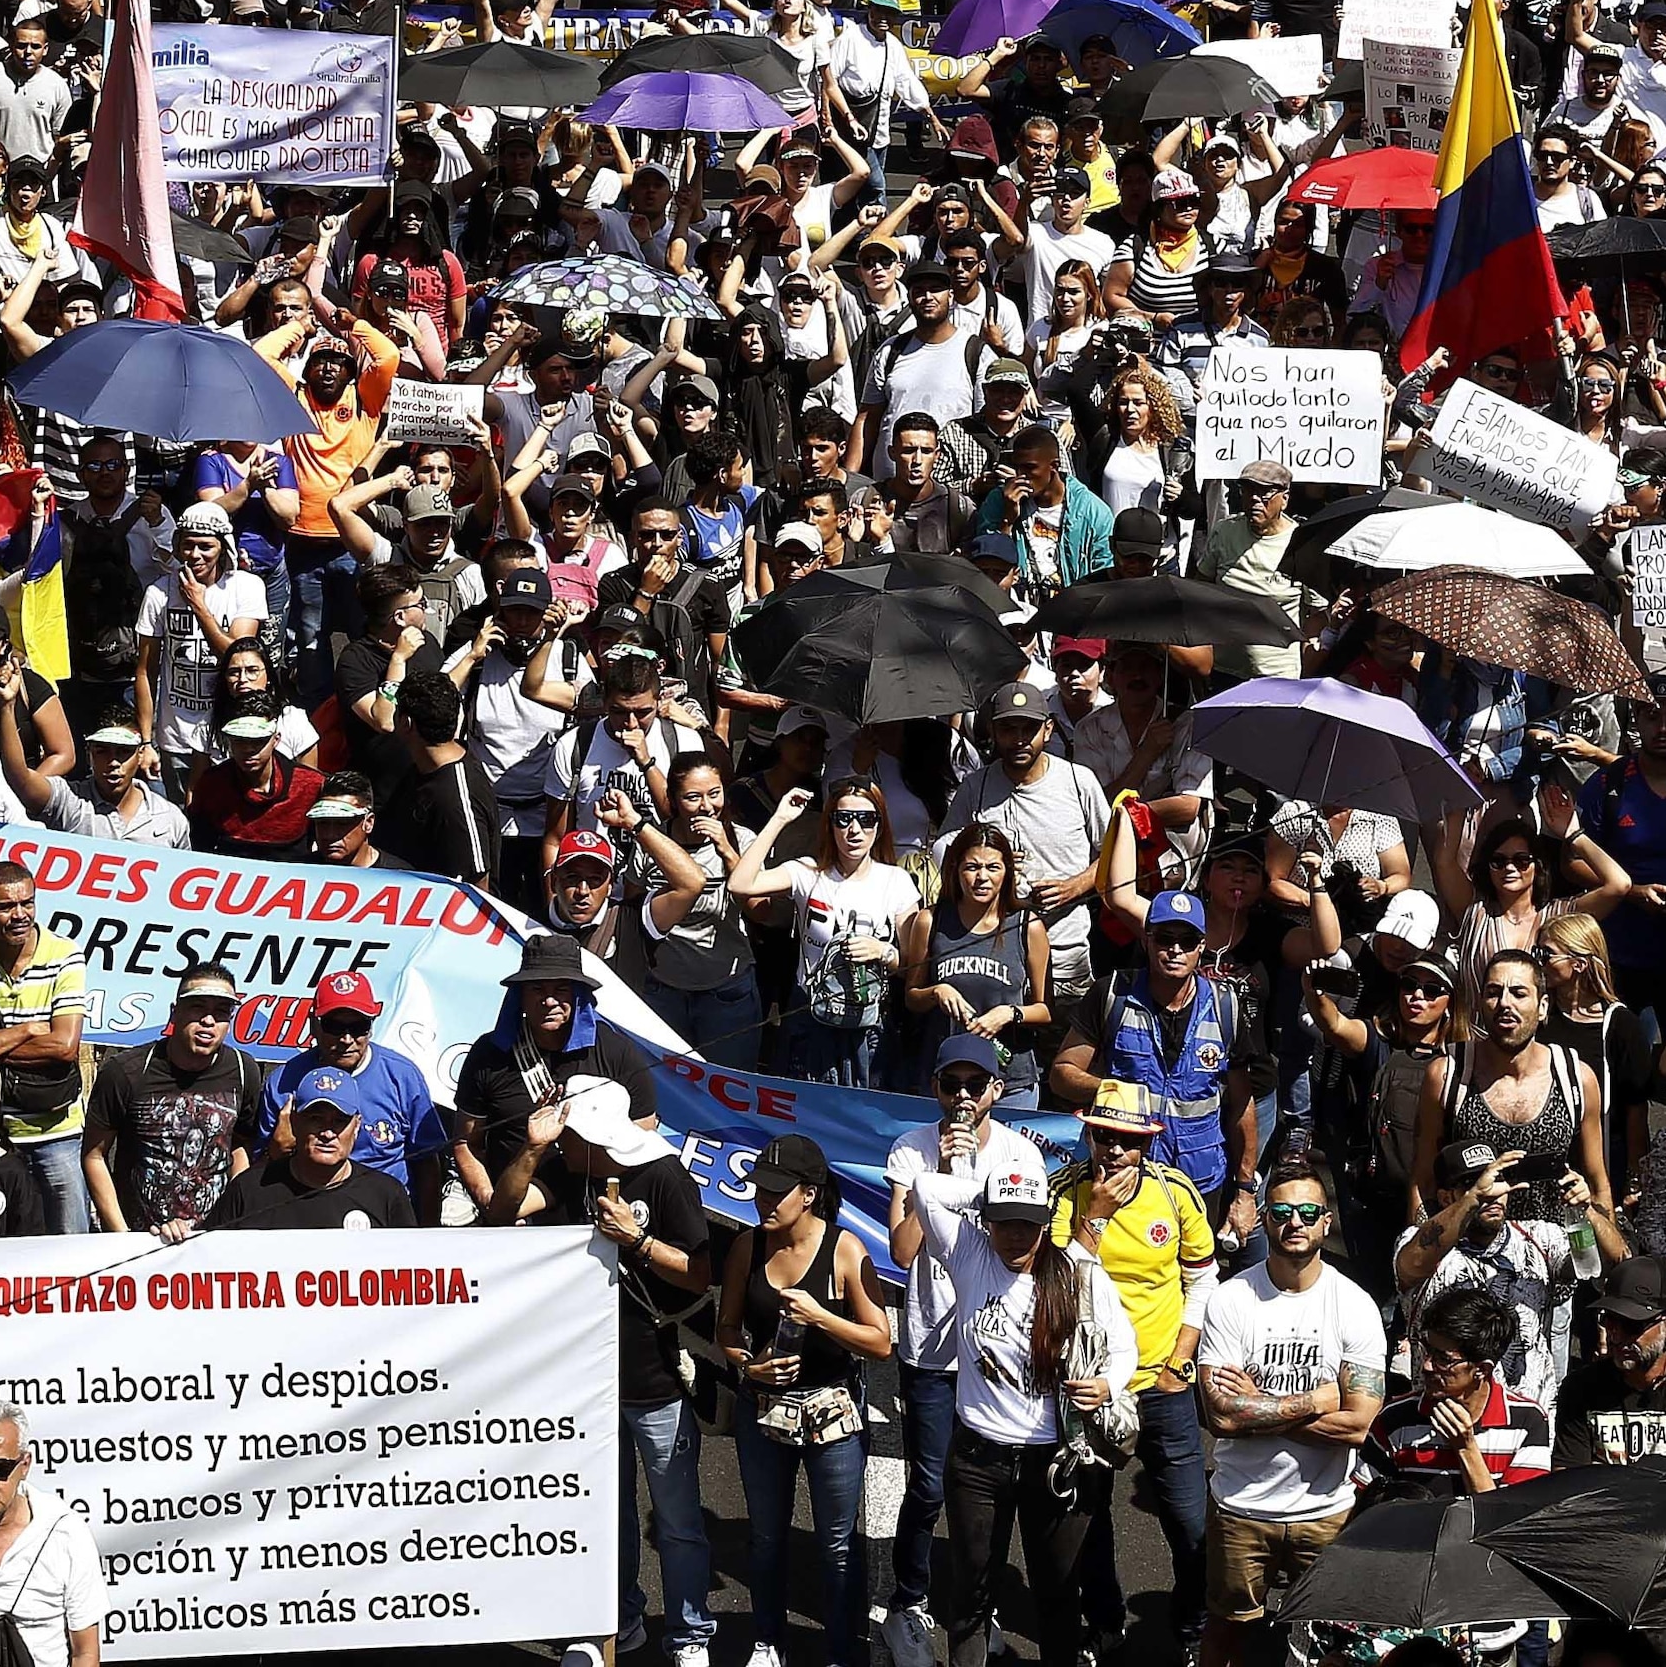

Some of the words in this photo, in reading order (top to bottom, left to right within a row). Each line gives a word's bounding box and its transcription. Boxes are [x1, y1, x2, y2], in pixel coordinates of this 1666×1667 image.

[1370, 43, 1382, 52] LA
[1431, 50, 1444, 60] NO
[1447, 53, 1459, 62] ES
[1384, 56, 1396, 65] UN
[316, 72, 382, 84] Sinaltrafamilia
[204, 79, 222, 105] LA
[230, 78, 338, 113] DESIGUALDAD
[1378, 88, 1392, 99] LO
[1419, 92, 1452, 106] HAGO
[159, 108, 214, 139] OCIAL
[223, 118, 238, 140] ES
[247, 114, 279, 141] MÁS
[287, 117, 375, 143] VIOLENTA
[1408, 111, 1429, 124] POR
[178, 147, 271, 173] CUALQUIER
[279, 147, 370, 173] PROTESTA
[1214, 352, 1268, 384] Nos
[1285, 354, 1335, 383] han
[391, 400, 431, 413] marcho
[436, 404, 453, 417] por
[461, 403, 477, 416] los
[396, 383, 409, 397] Yo
[411, 385, 463, 403] también
[1208, 388, 1287, 412] quitado
[1289, 386, 1351, 408] tanto
[401, 426, 416, 437] los
[419, 426, 459, 441] bosques
[441, 415, 450, 426] el
[1205, 415, 1244, 437] que
[1251, 415, 1288, 430] nos
[1299, 410, 1378, 436] quitaron
[1461, 390, 1549, 451] ESTAMOS
[1556, 436, 1594, 474] TAN
[1215, 438, 1238, 461] el
[1257, 435, 1355, 469] Miedo
[1436, 440, 1489, 479] HASTA
[1448, 418, 1537, 474] ENOJADOS
[1542, 466, 1586, 498] QUE
[1431, 456, 1468, 484] VINO
[1470, 479, 1487, 493] A
[1489, 487, 1573, 528] MARCHAR
[1635, 575, 1653, 594] TU
[166, 865, 515, 947] GUADALU
[47, 909, 391, 990] PRESENTE
[936, 954, 1013, 987] BUCKNELL
[1100, 1108, 1147, 1125] COLOMBIA
[998, 1186, 1038, 1200] PROFE
[147, 1270, 285, 1312] CONTRA
[295, 1266, 480, 1310] COLOMBIA:
[76, 1361, 216, 1406] laboral
[226, 1375, 247, 1409] y
[260, 1359, 451, 1413] despidos.
[204, 1433, 225, 1466] y
[237, 1422, 368, 1460] menos
[378, 1411, 588, 1464] pensiones.
[102, 1480, 243, 1524] bancos
[251, 1485, 274, 1522] y
[286, 1464, 593, 1519] privatizaciones.
[224, 1548, 245, 1583] y
[260, 1537, 388, 1573] menos
[399, 1522, 590, 1563] derechos.
[102, 1597, 270, 1645] públicos
[279, 1590, 360, 1627] más
[367, 1587, 483, 1622] caros.
